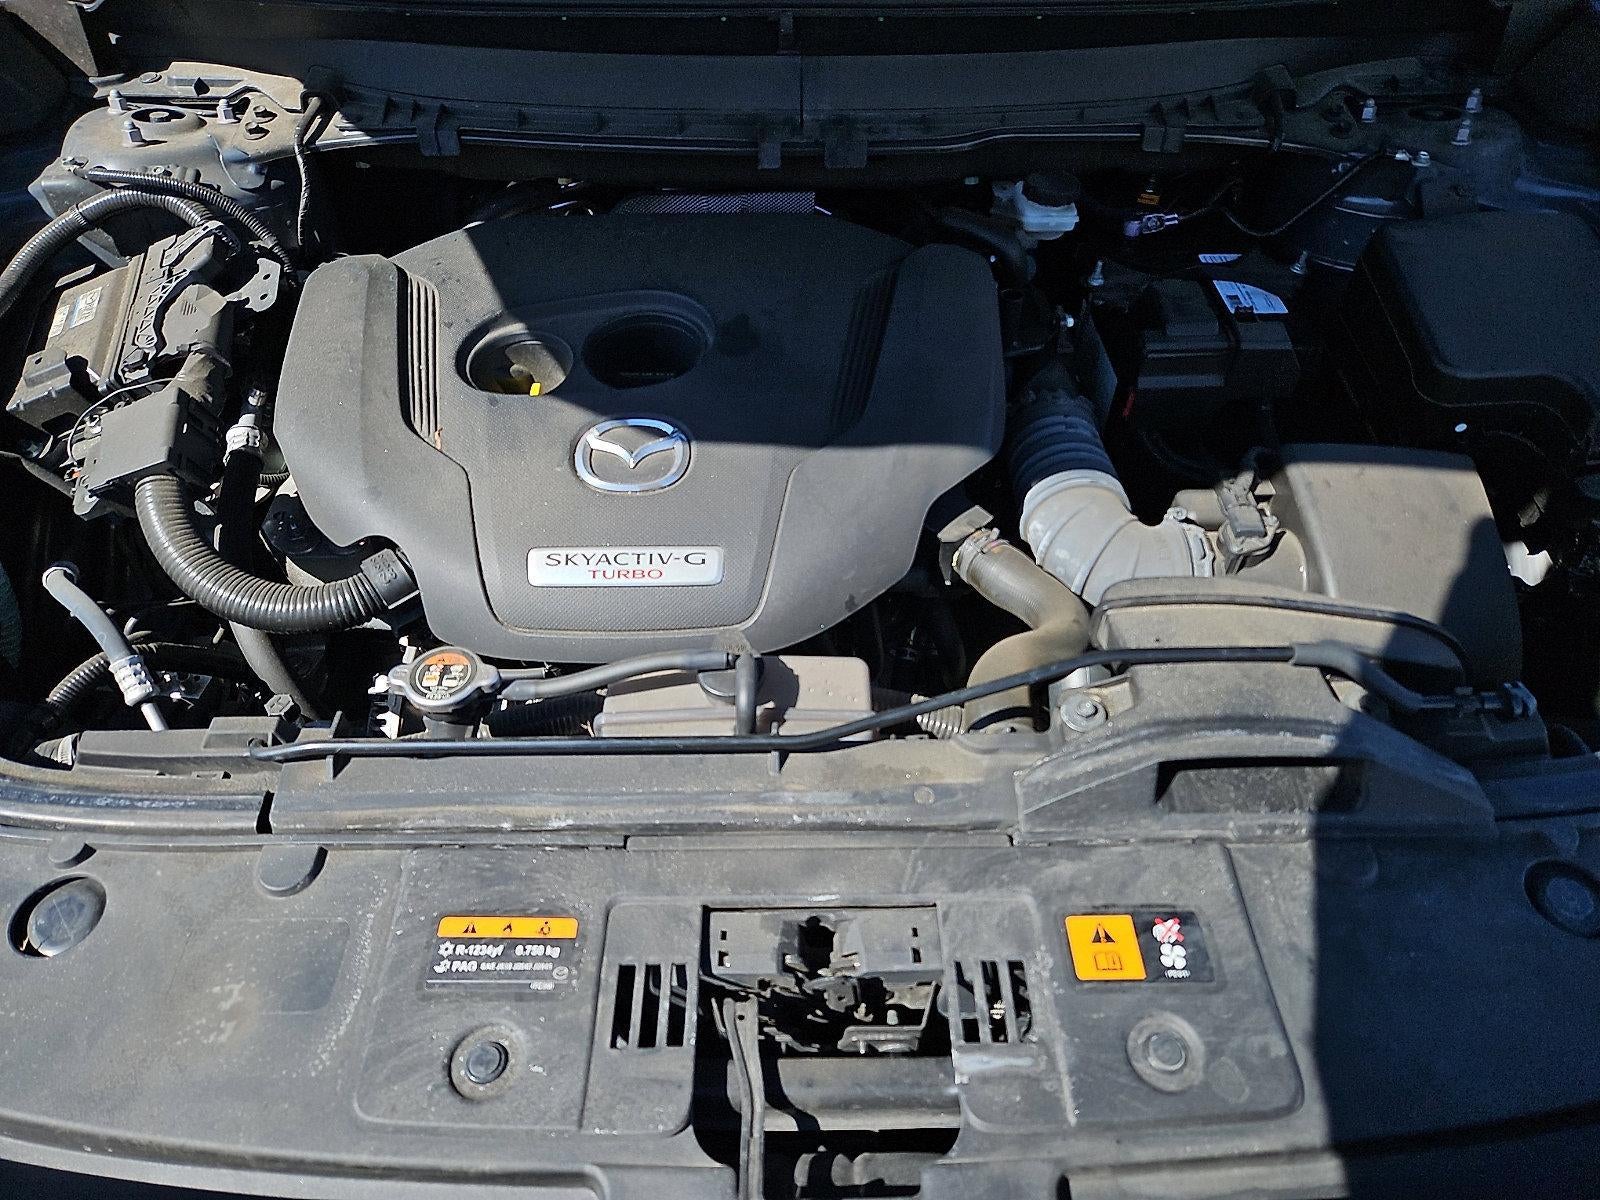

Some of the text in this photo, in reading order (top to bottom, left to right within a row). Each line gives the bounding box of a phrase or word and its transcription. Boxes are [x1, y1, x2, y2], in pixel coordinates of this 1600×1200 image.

[545, 552, 707, 567] SKYACTIV-G
[588, 569, 664, 580] TURBO
[545, 945, 561, 958] kg
[451, 960, 478, 972] PAG
